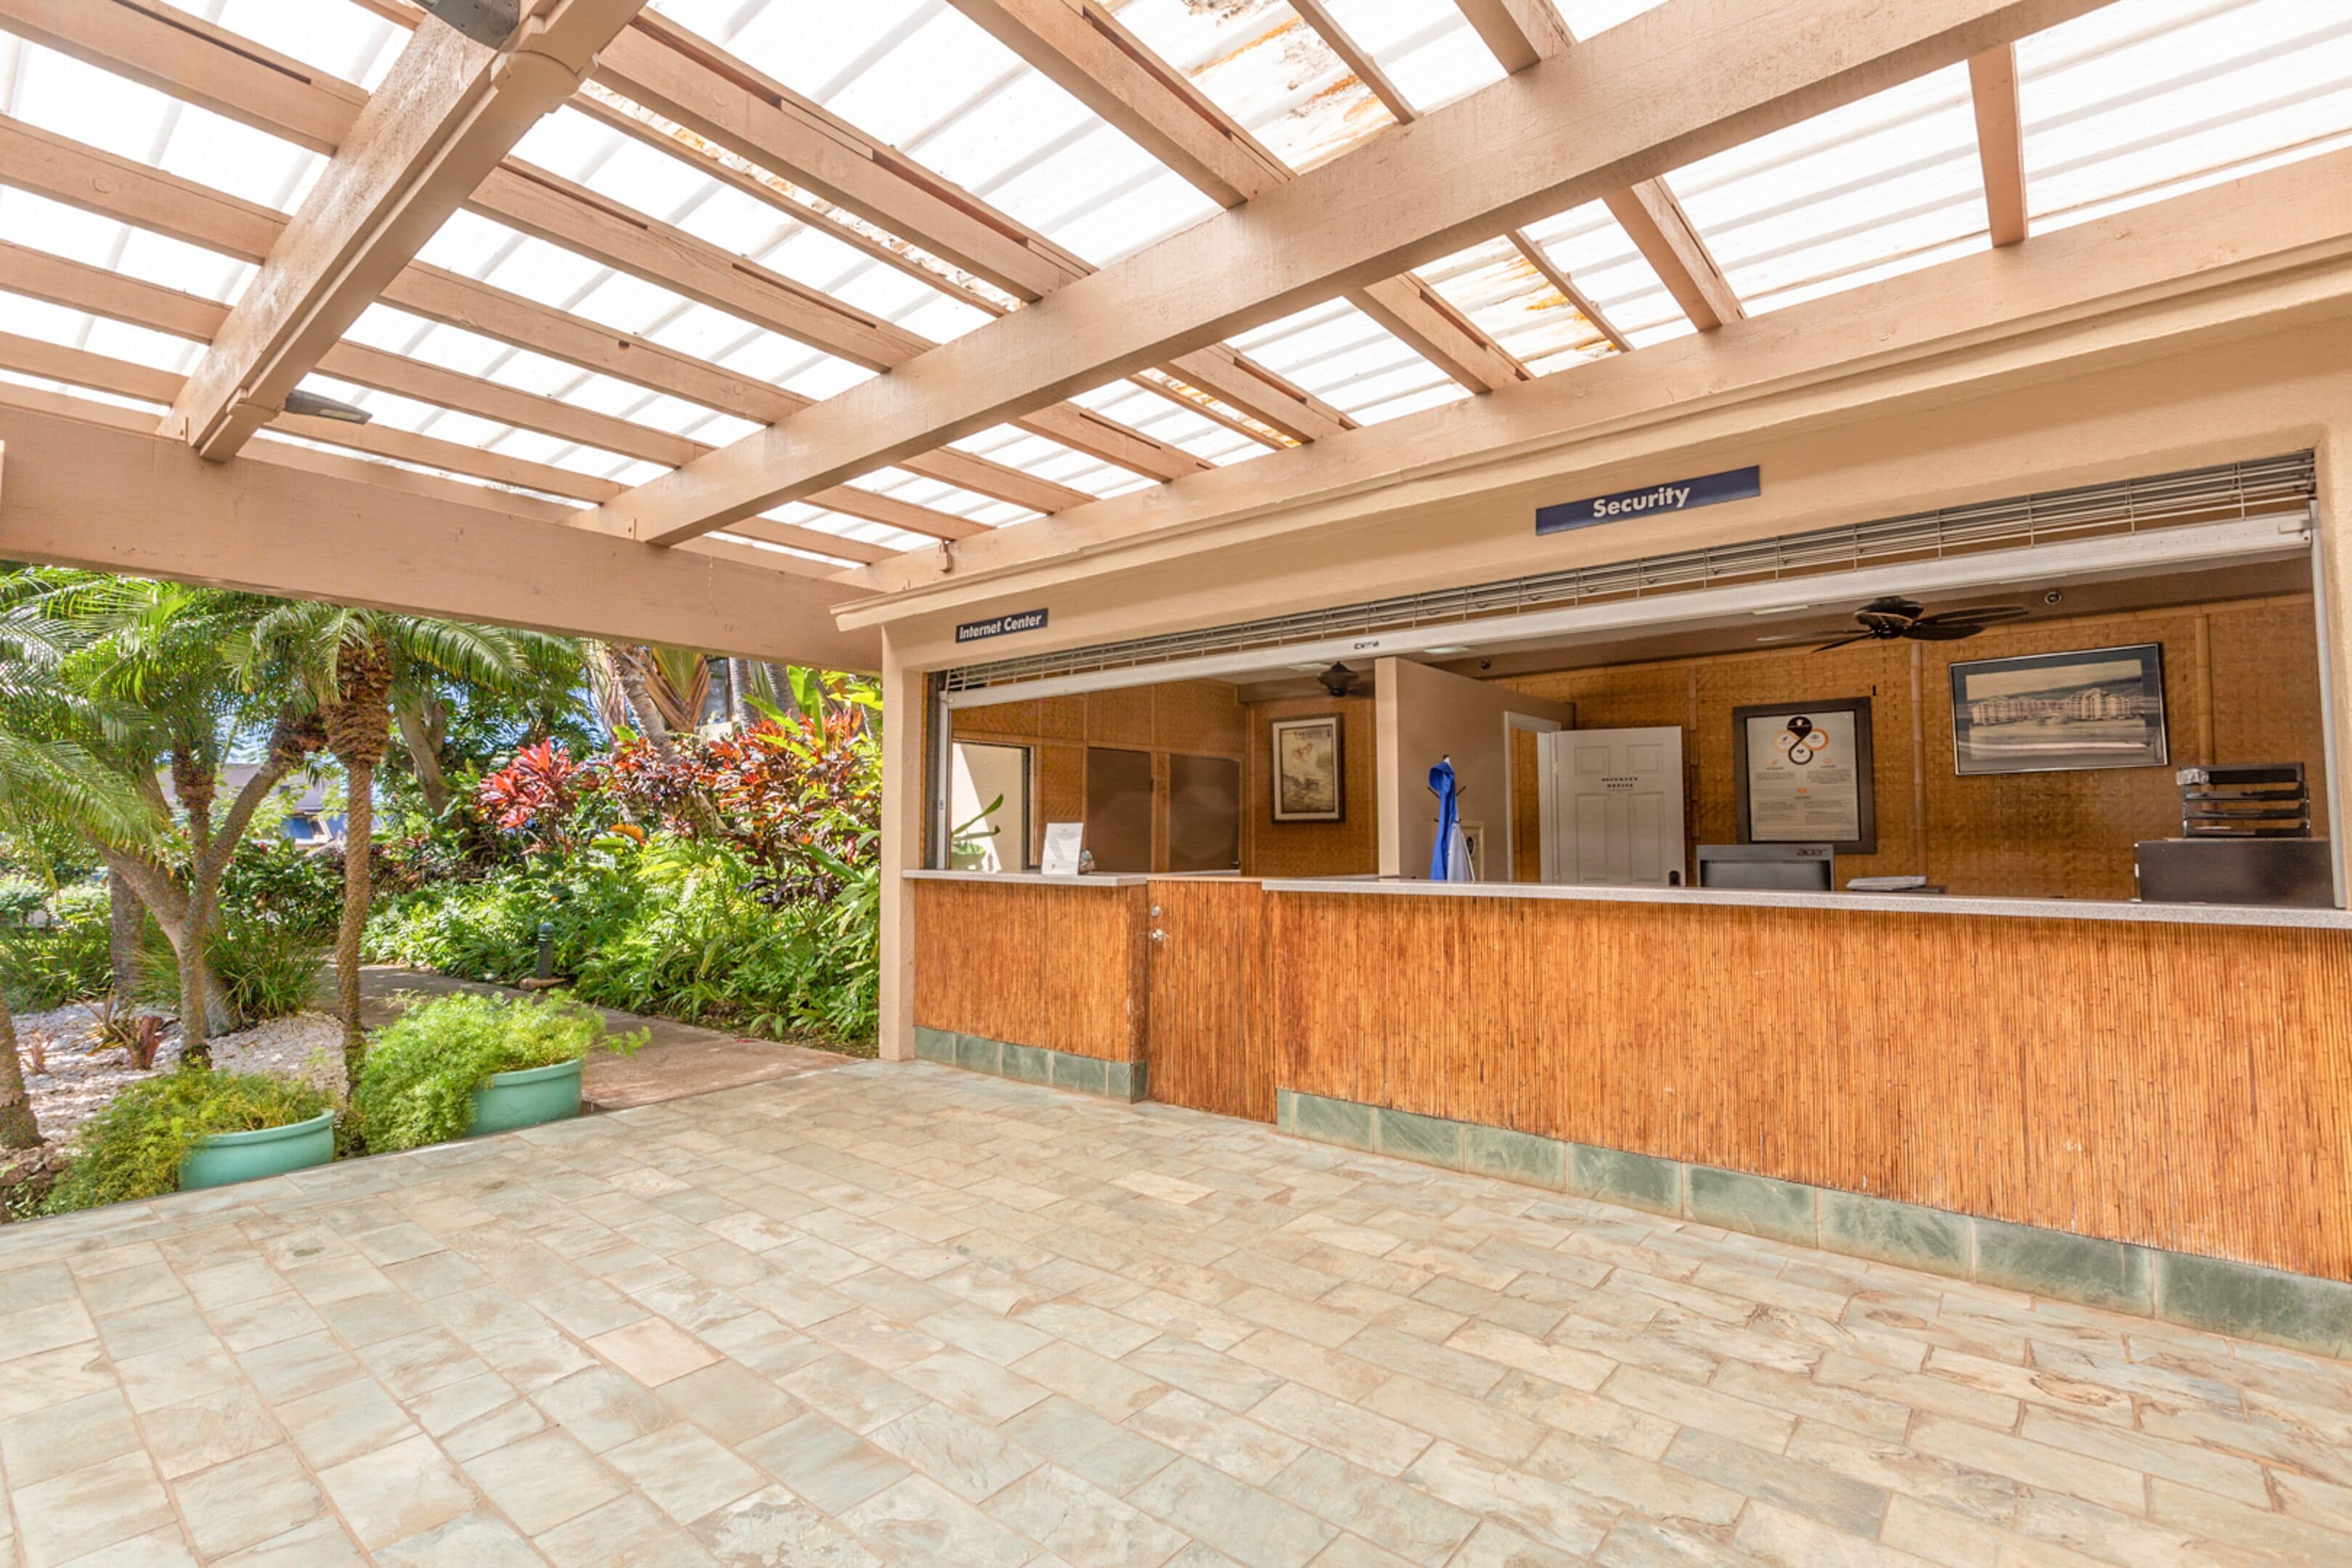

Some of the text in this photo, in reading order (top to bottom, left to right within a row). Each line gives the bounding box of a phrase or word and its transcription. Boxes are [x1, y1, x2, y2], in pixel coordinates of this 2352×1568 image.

[1593, 486, 1691, 518] Security
[959, 615, 1042, 640] Internet Center
